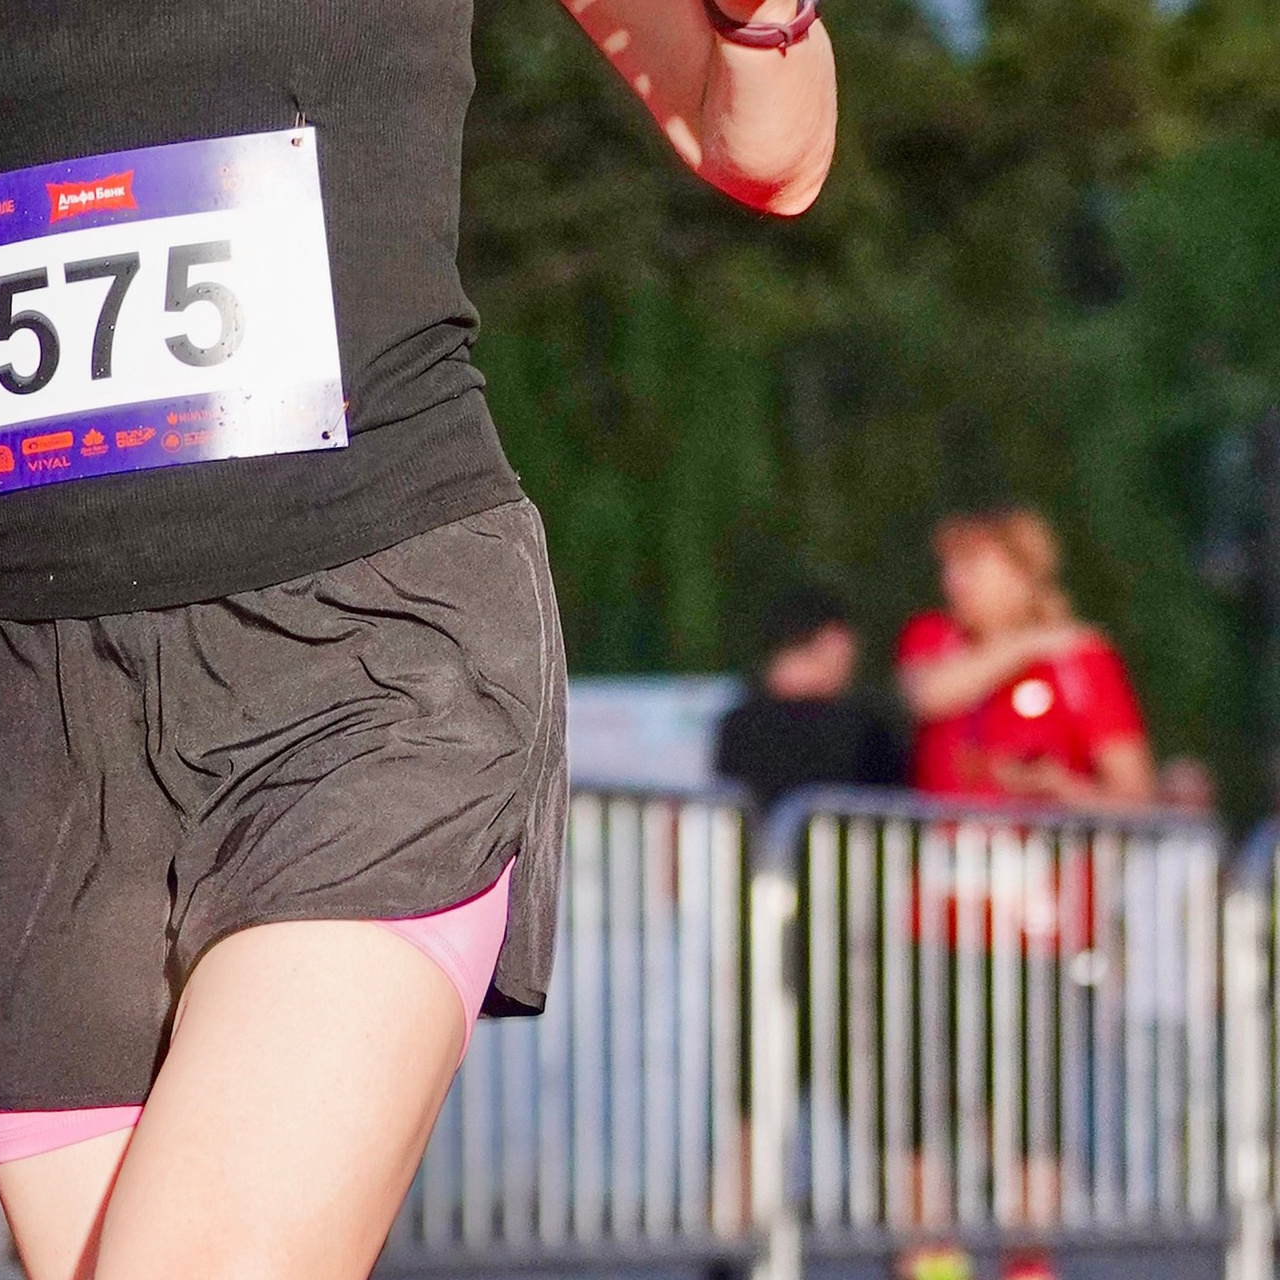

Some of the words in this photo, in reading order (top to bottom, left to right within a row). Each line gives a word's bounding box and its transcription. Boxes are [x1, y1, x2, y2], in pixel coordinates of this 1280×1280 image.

[58, 189, 95, 208] Альфа
[95, 185, 125, 199] Банк
[28, 456, 71, 472] VIVAL
